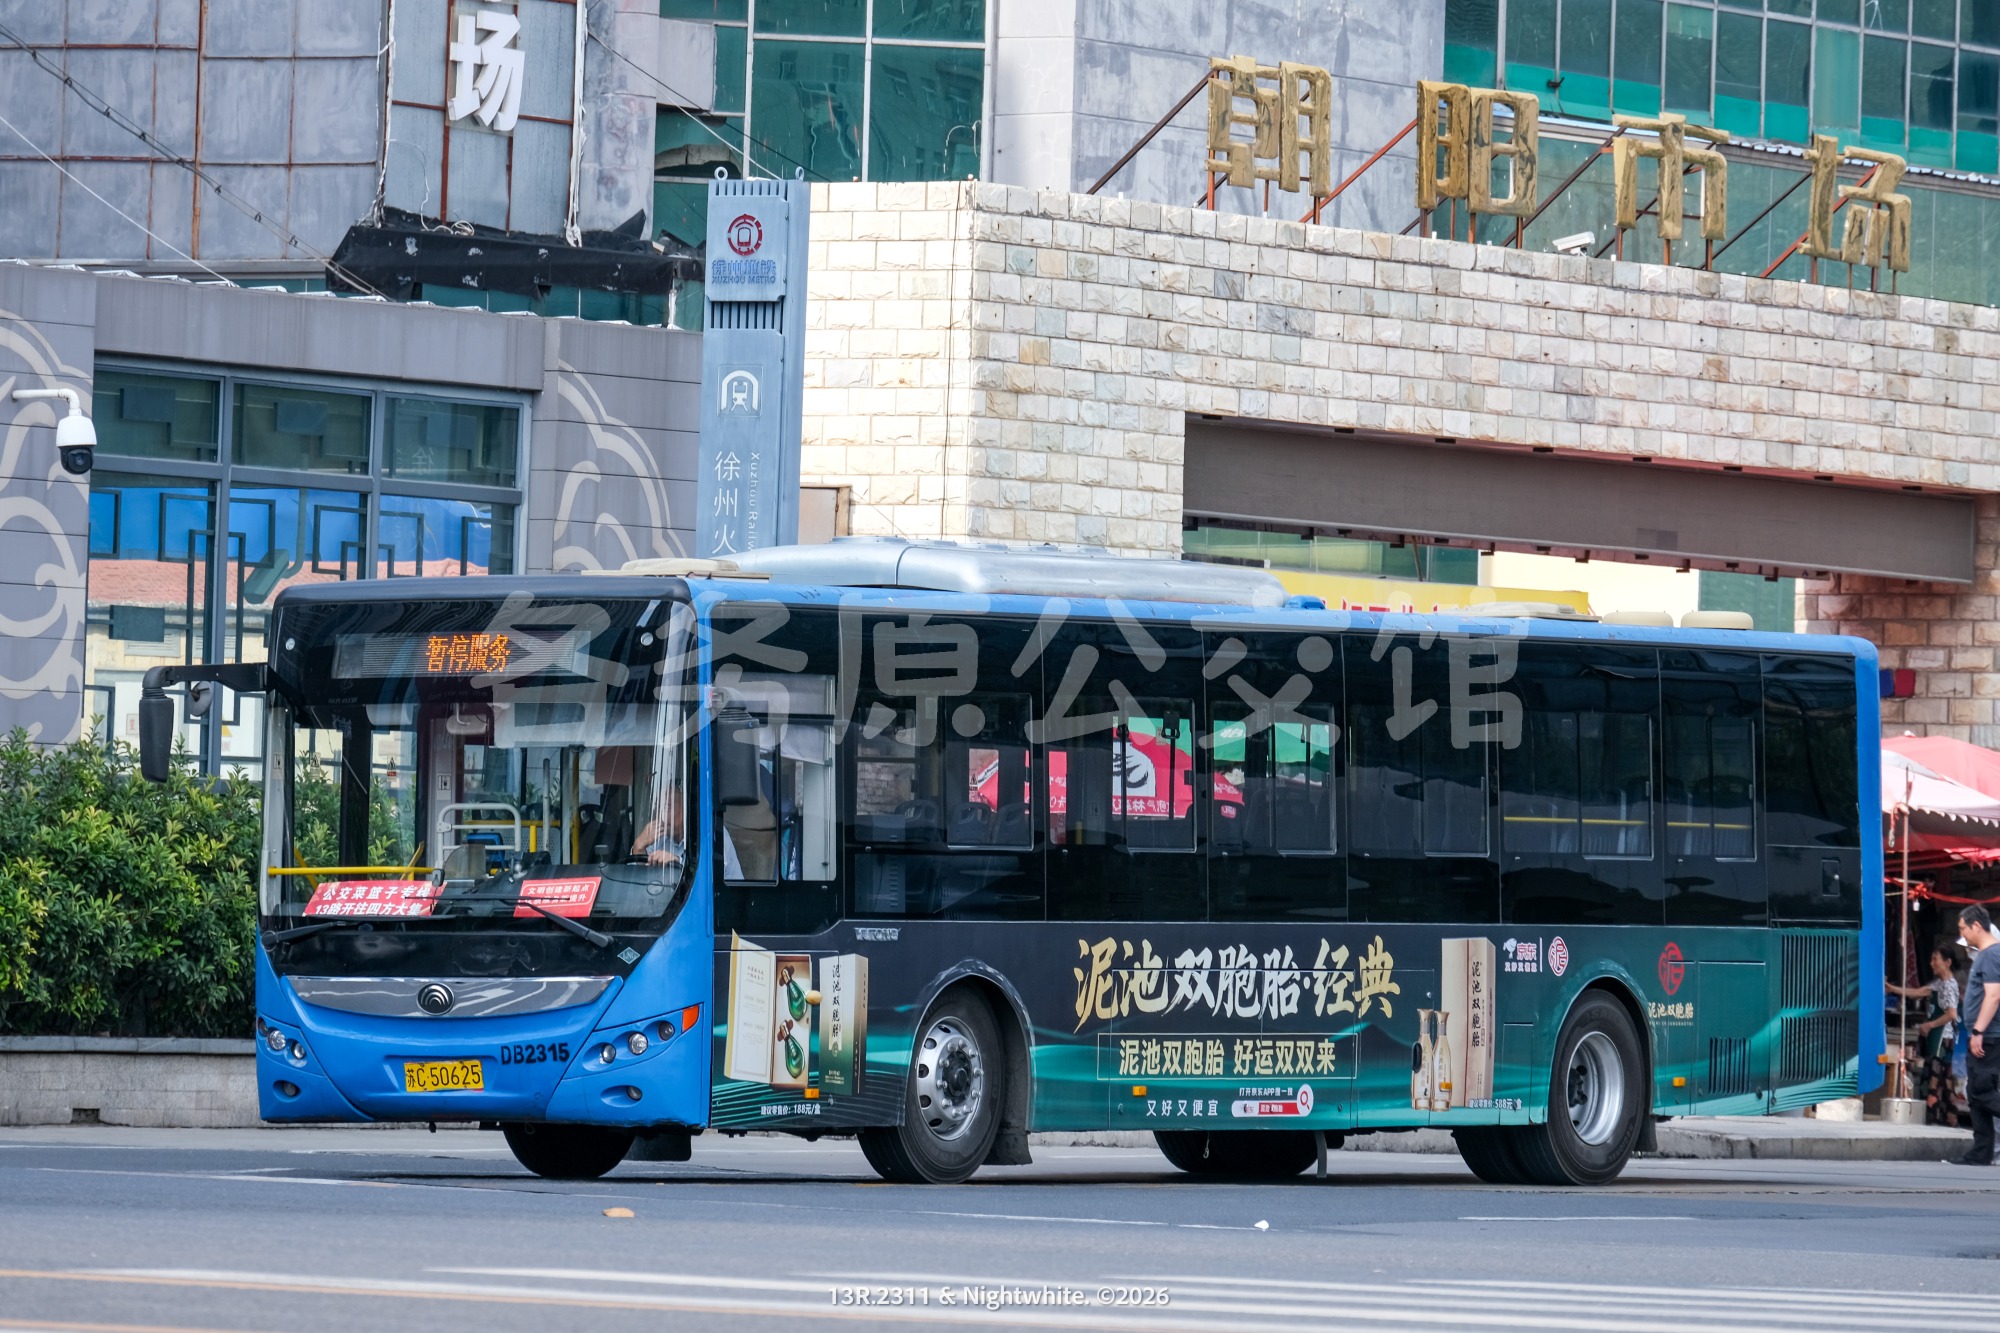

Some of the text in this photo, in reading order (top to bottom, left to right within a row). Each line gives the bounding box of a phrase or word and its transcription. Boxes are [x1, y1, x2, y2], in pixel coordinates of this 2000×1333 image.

[448, 10, 525, 131] 场
[711, 259, 777, 276] 徐州地铁
[711, 275, 776, 284] XUZHOU METRO
[748, 451, 760, 508] Xuzhou
[712, 451, 741, 554] 徐州火
[425, 634, 512, 673] 暂停服务
[322, 884, 431, 901] 公交菜篮子专线
[527, 884, 590, 895] 文明创建新起点
[315, 902, 423, 916] 13路开往四方大集
[1516, 942, 1538, 961] 京东
[1648, 1001, 1694, 1020] 泥池双胞胎
[501, 1043, 570, 1065] DB2315
[1118, 1038, 1336, 1076] 泥池双胞胎 好运双双来
[1146, 1099, 1219, 1117] 又好又便宜
